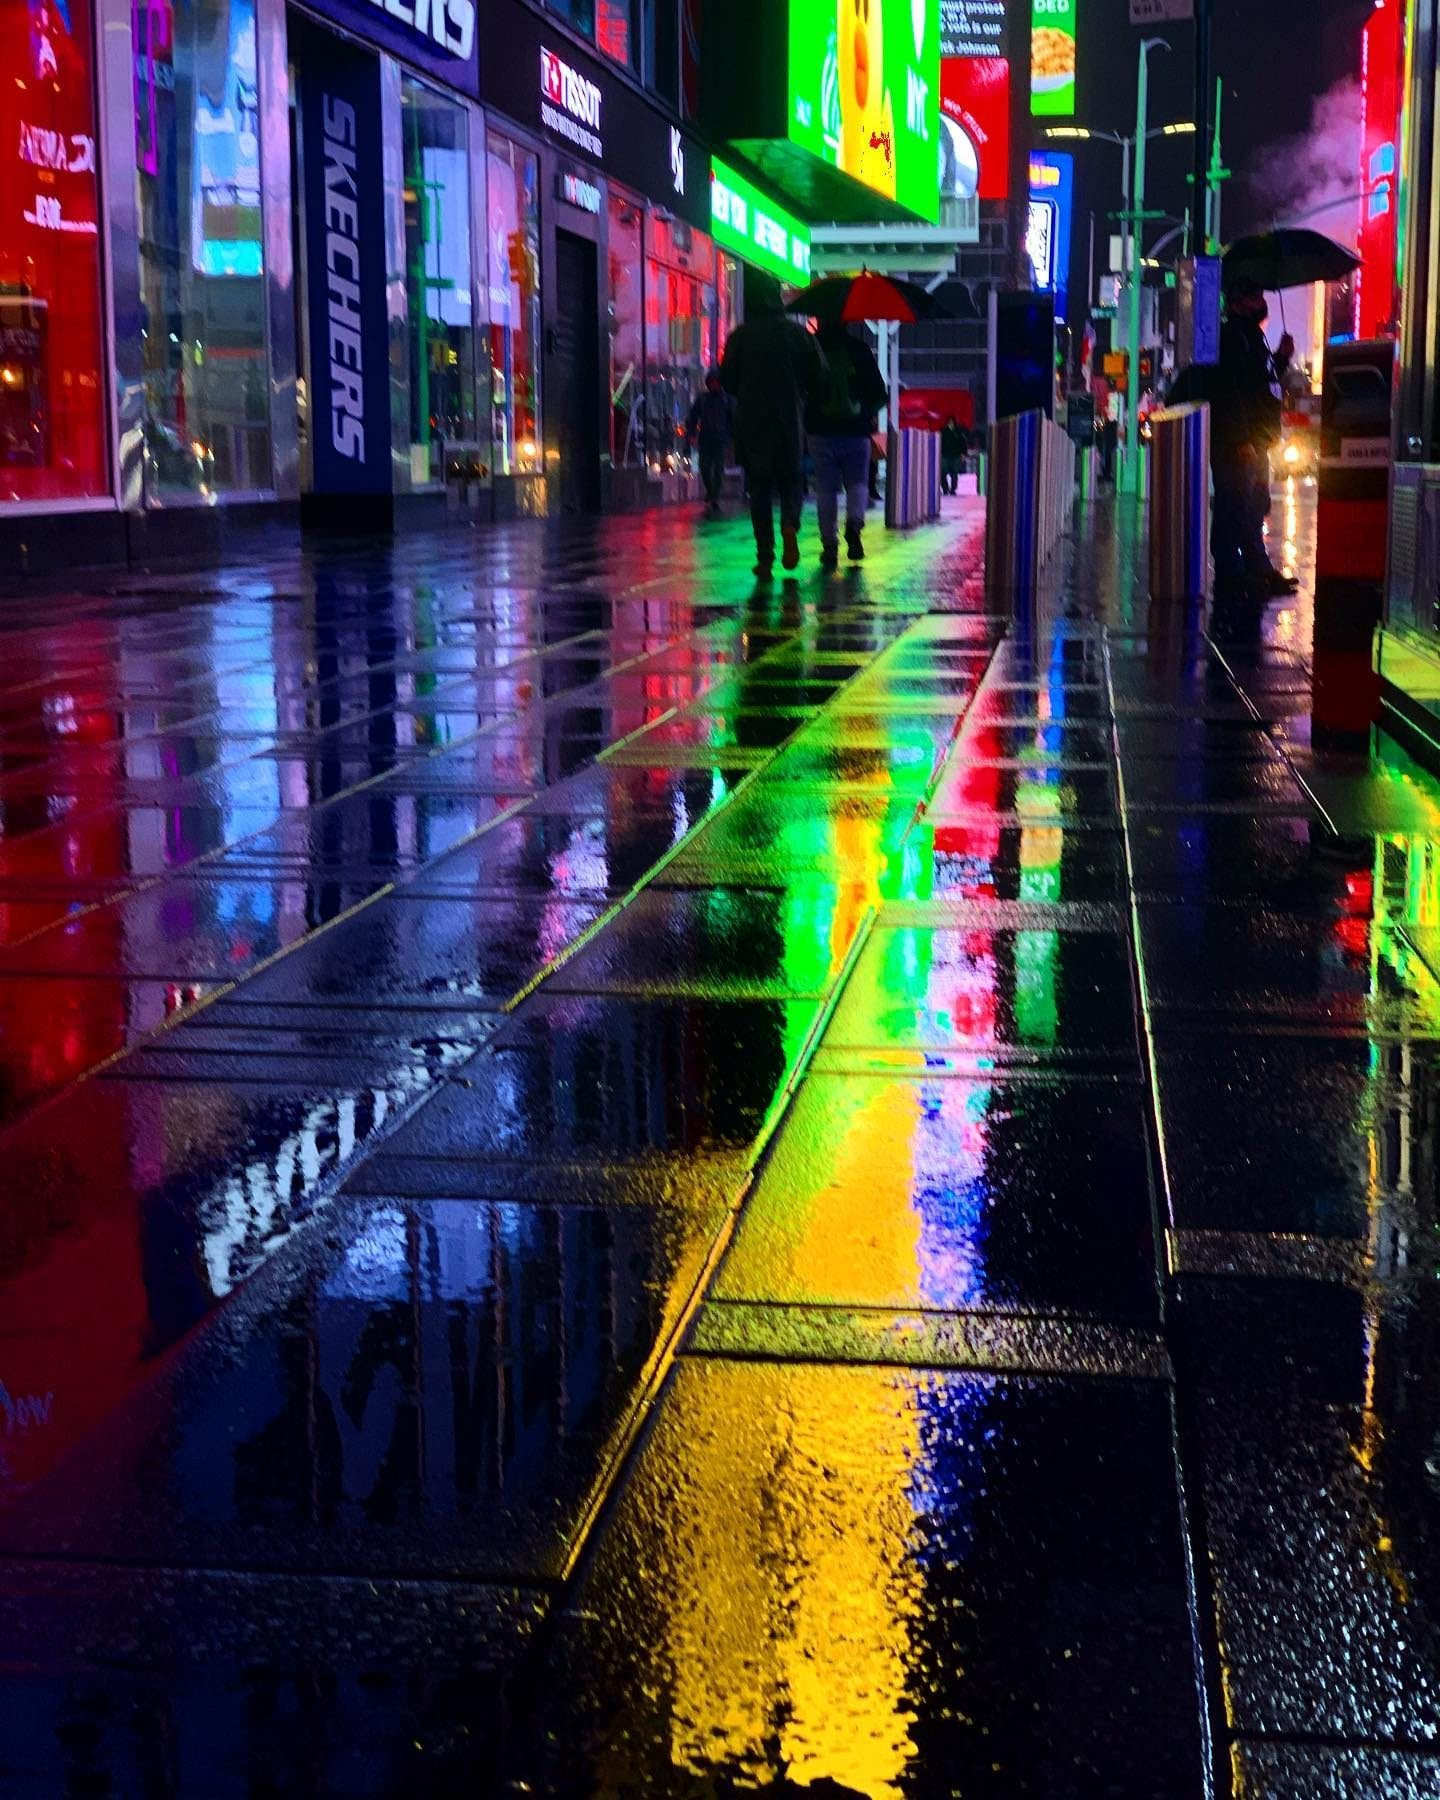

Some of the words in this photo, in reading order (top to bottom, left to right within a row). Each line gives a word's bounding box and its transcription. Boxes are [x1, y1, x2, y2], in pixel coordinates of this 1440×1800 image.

[956, 41, 1001, 56] Johnson
[560, 60, 603, 130] TISSOT
[321, 93, 366, 466] SKECHERS
